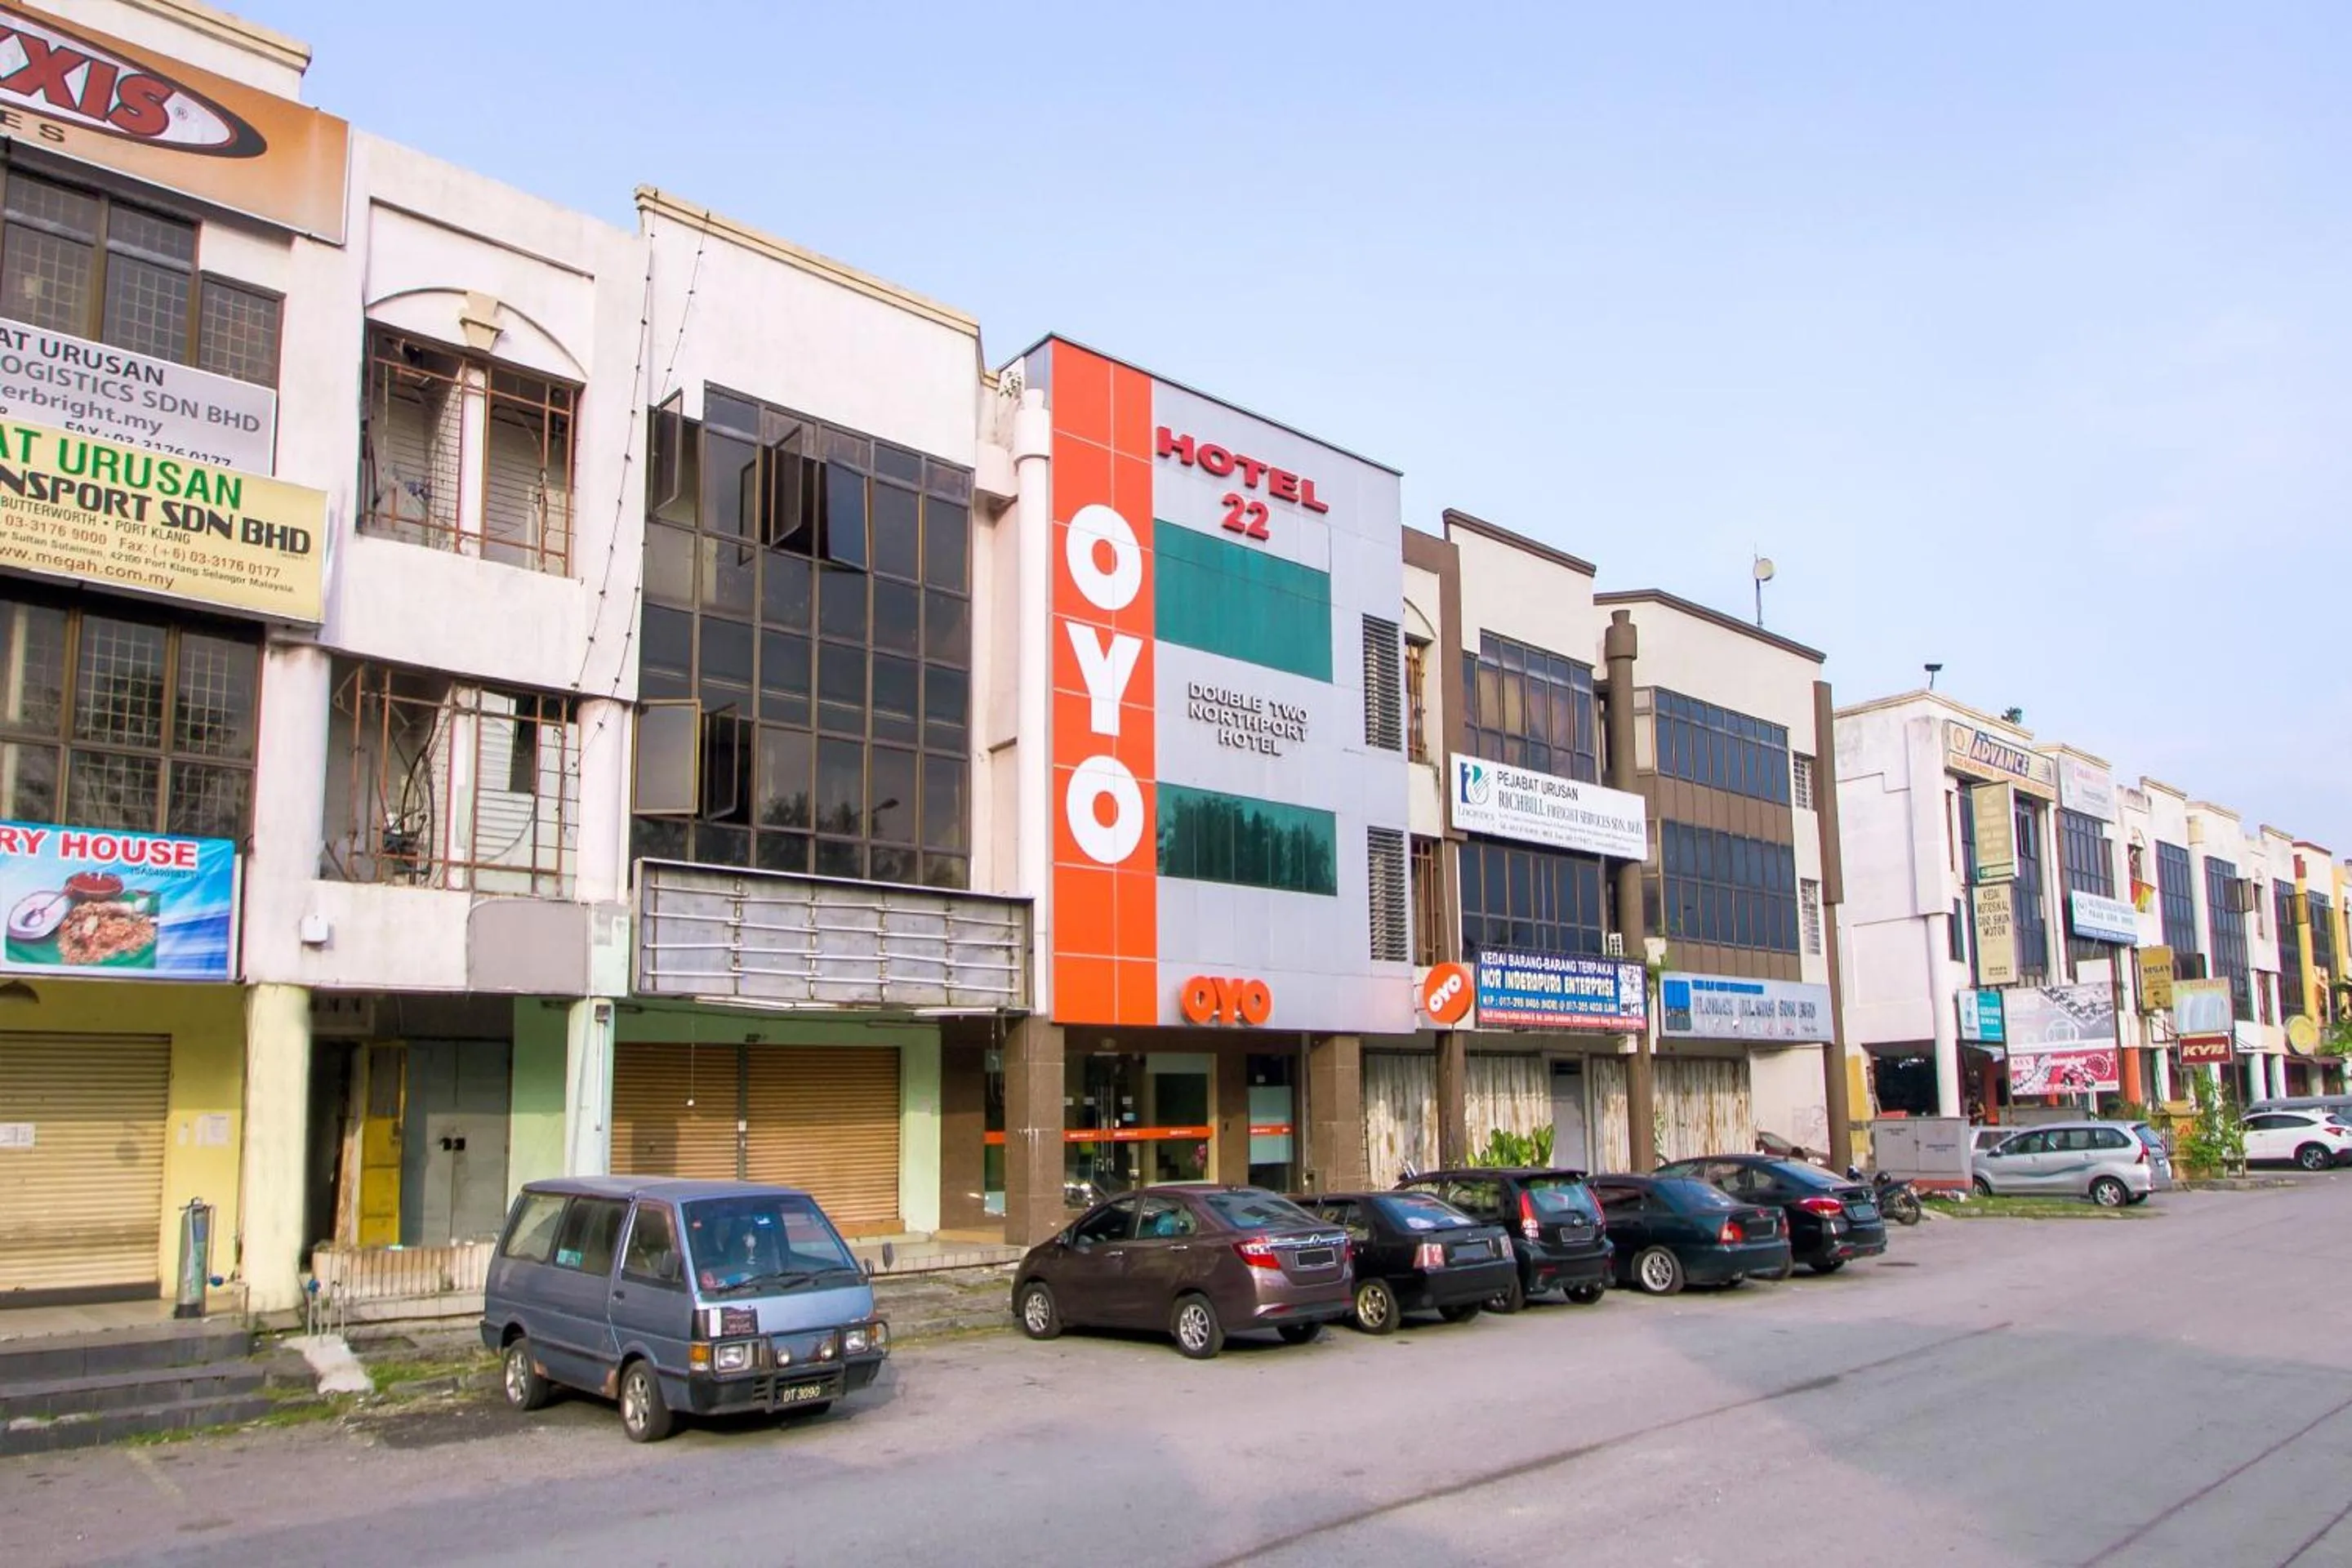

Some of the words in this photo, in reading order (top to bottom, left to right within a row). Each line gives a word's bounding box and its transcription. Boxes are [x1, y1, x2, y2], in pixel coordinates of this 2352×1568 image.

[0, 25, 174, 137] XIS
[39, 337, 164, 386] URUSAN
[0, 354, 134, 403] OGISTICS
[142, 389, 199, 419] SDN
[207, 405, 261, 434] BHD
[0, 384, 163, 436] erbright.my
[59, 438, 242, 510] URUSAN
[1156, 425, 1330, 514] HOTEL
[1, 495, 97, 526] BUTTERWORTH
[115, 519, 147, 536] PORT
[151, 527, 190, 545] KLANG
[161, 499, 234, 541] SDN
[241, 516, 311, 555] BHD
[1221, 492, 1270, 541] 22
[5, 514, 67, 537] 03-3176
[248, 563, 281, 578] 0177
[1187, 682, 1263, 714] DOUBLE
[1267, 700, 1309, 723] TWO
[1187, 702, 1309, 742] NORTHPORT
[1218, 724, 1282, 757] HOTEL
[1969, 738, 2029, 777] ADVANCE
[1497, 771, 1539, 791] PEJABAT
[1541, 779, 1578, 800] URUSAN
[61, 833, 197, 867] HOUSE
[1481, 951, 1507, 965] KEDAI
[1481, 968, 1502, 989] NOR
[1181, 975, 1272, 1026] OYO
[1429, 973, 1462, 1012] OYO
